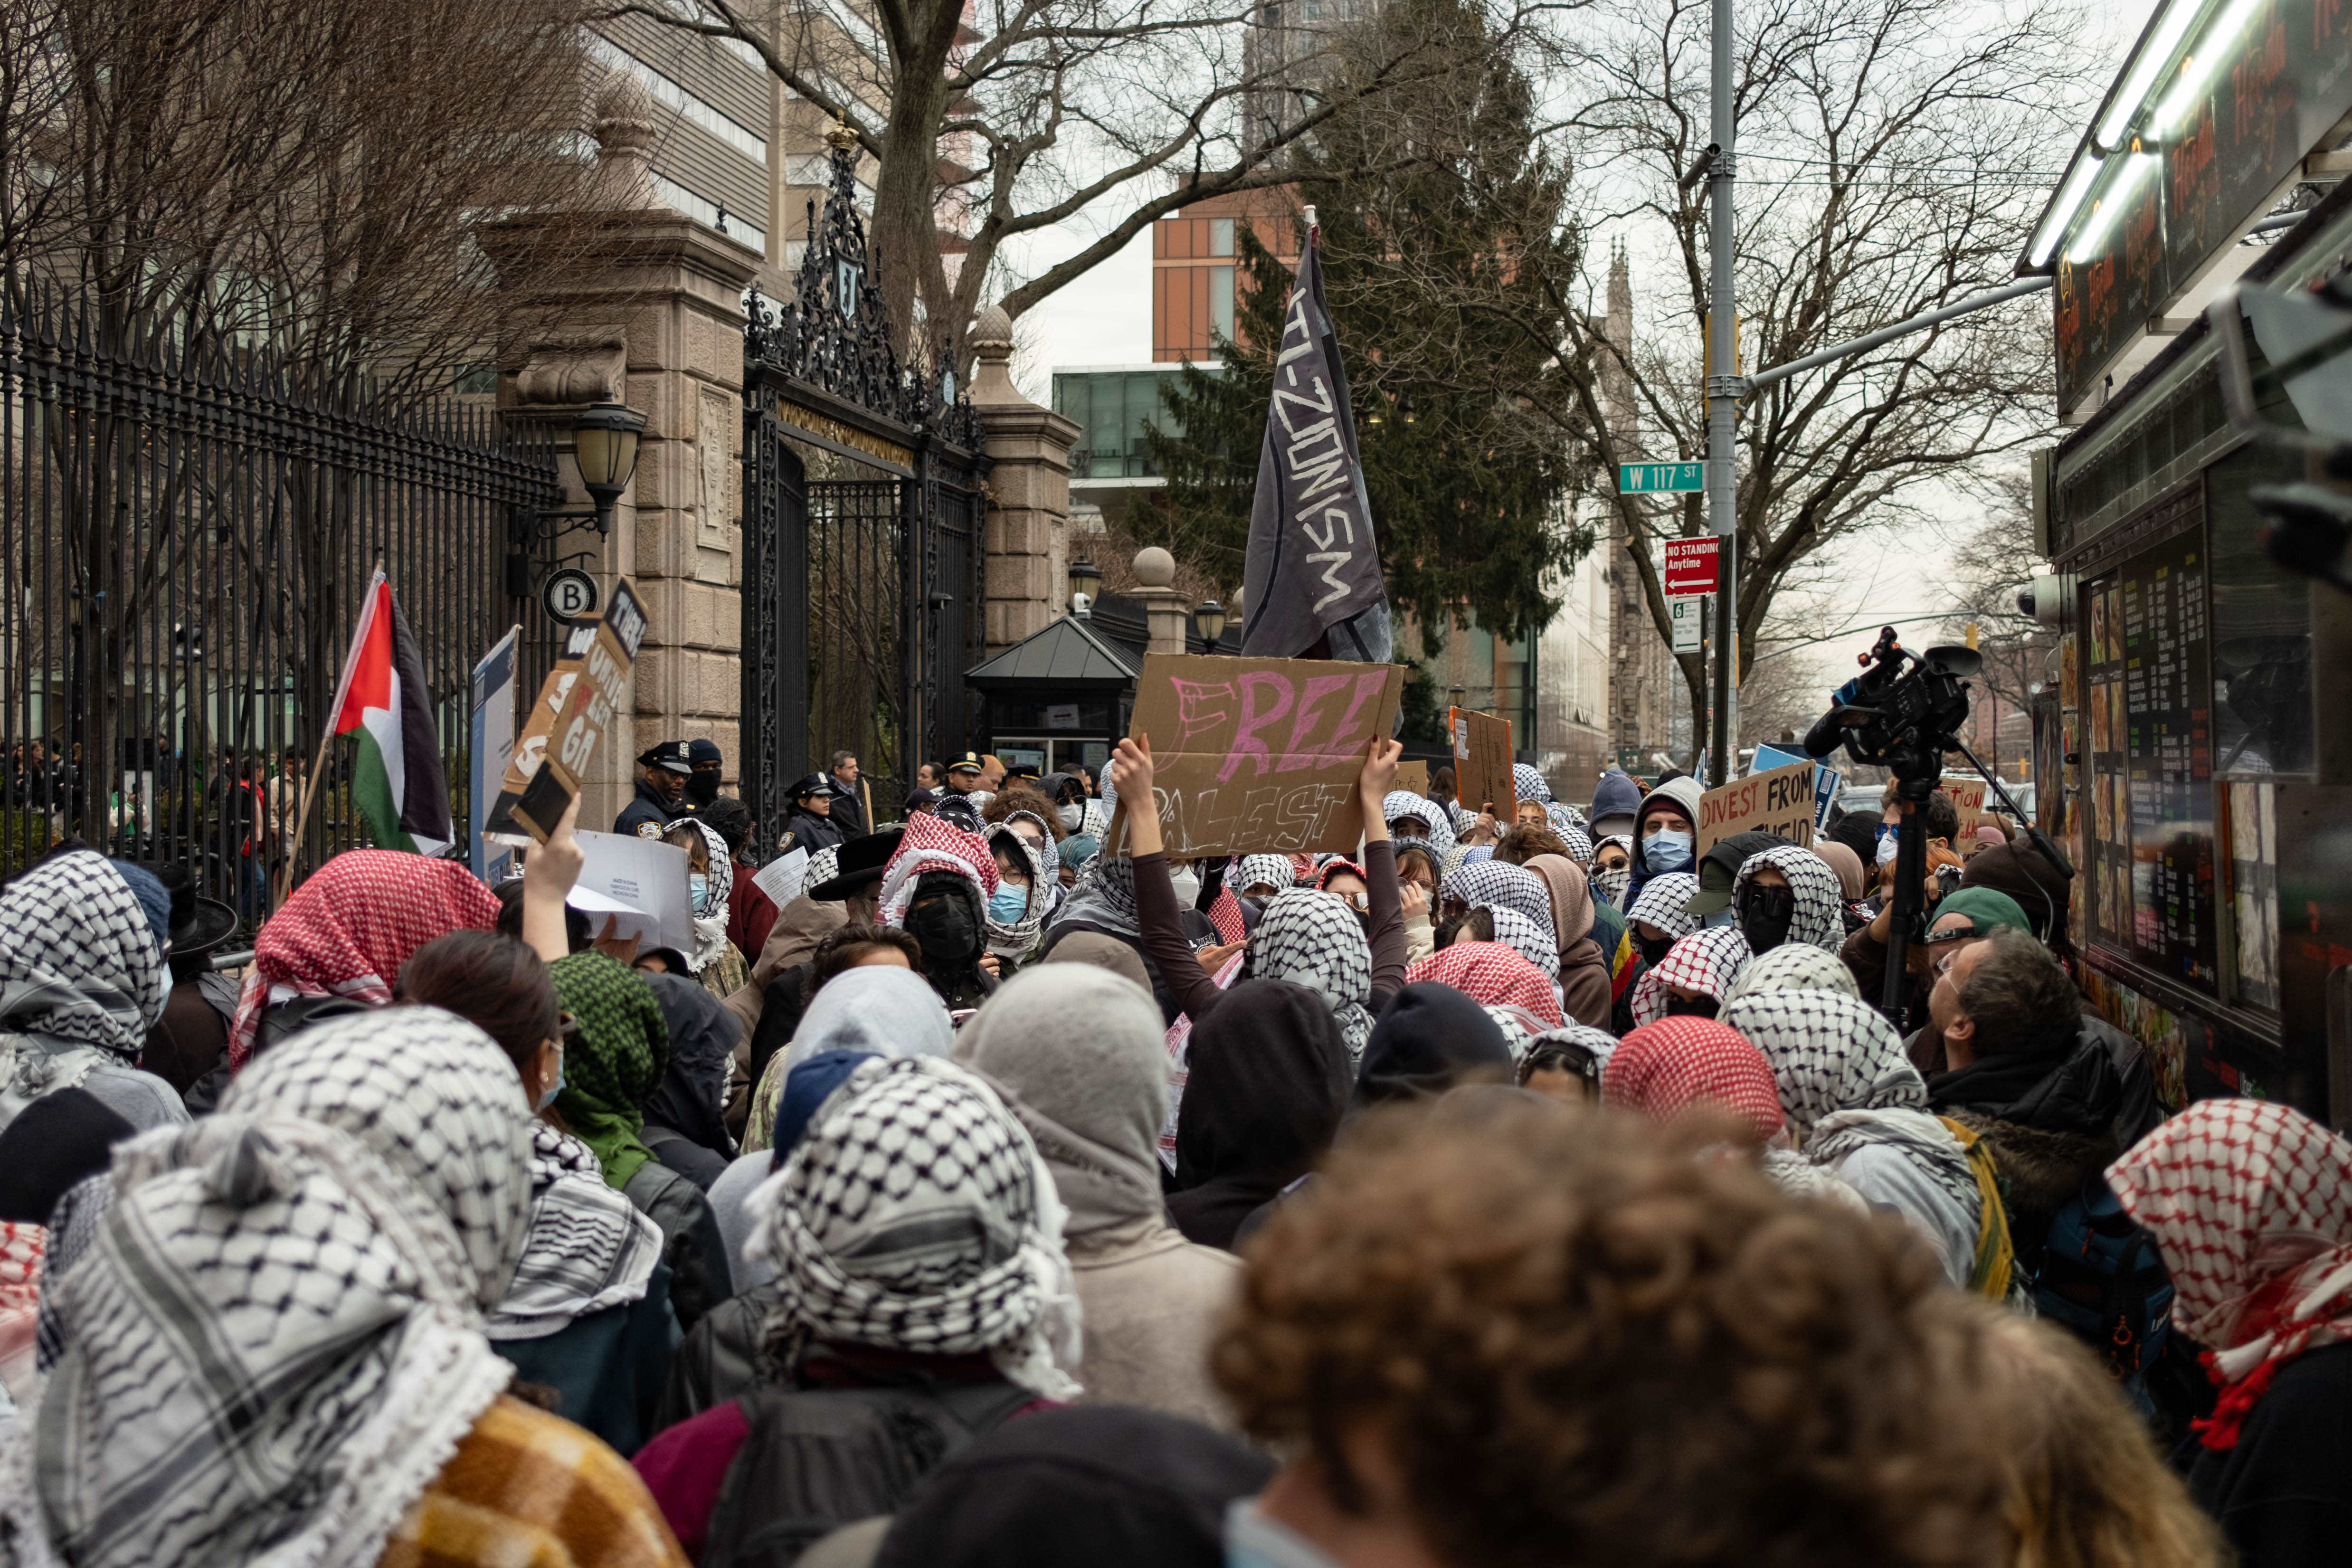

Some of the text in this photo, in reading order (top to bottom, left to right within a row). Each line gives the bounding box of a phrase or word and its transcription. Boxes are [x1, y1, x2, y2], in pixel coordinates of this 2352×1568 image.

[1273, 287, 1354, 615] TI-ZIONISM
[1630, 466, 1697, 489] W 117 ST
[1668, 546, 1679, 557] NO
[1668, 558, 1701, 571] Anytime
[562, 584, 581, 610] B
[1676, 604, 1682, 618] 6
[1151, 669, 1389, 782] FREE
[1702, 780, 1759, 830] DIVEST
[1767, 766, 1812, 812] FROM
